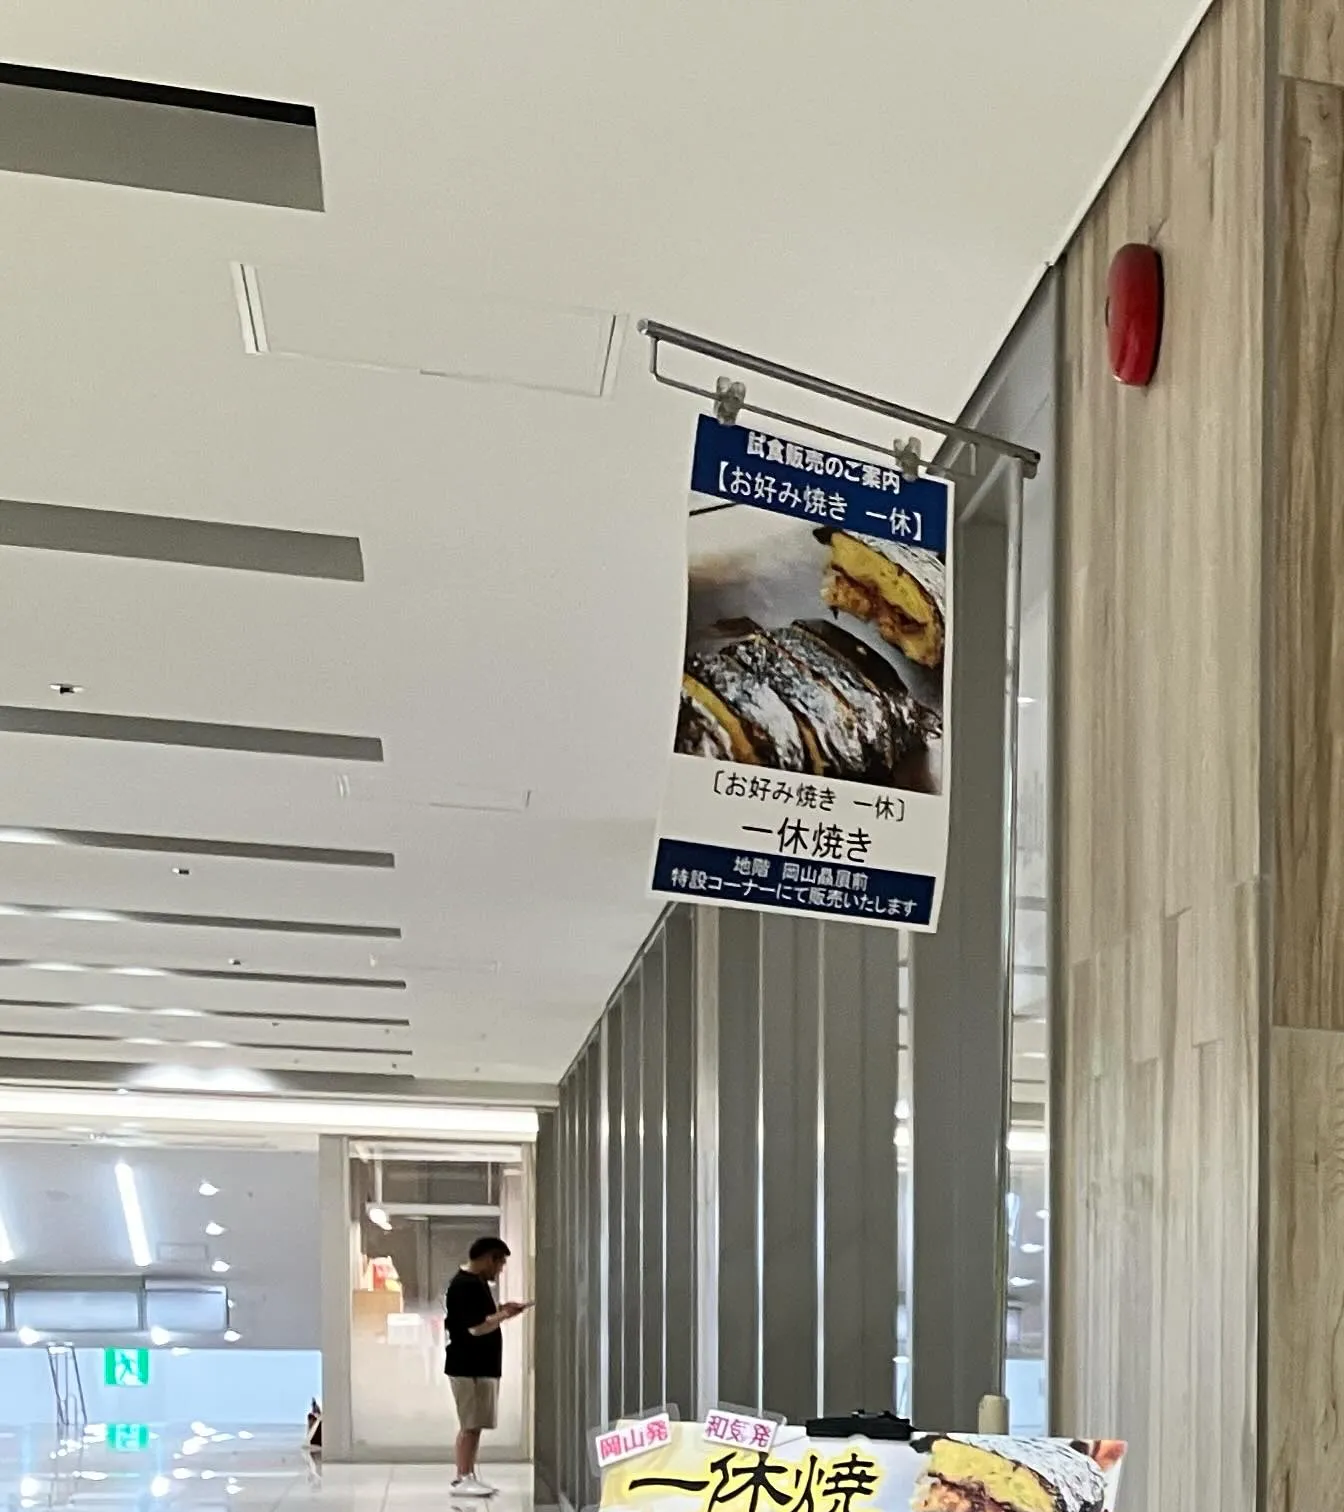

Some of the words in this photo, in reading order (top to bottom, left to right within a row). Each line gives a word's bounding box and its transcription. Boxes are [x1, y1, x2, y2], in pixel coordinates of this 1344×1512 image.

[746, 431, 901, 495] 試食販売のご案内
[717, 460, 848, 521] 【お好み焼き
[741, 816, 872, 863] 一休焼き
[732, 856, 771, 877] 地階
[671, 867, 918, 917] 特設コーナーにて販売いたします
[600, 1421, 669, 1459] 岡山発
[706, 1414, 772, 1449] 和気発
